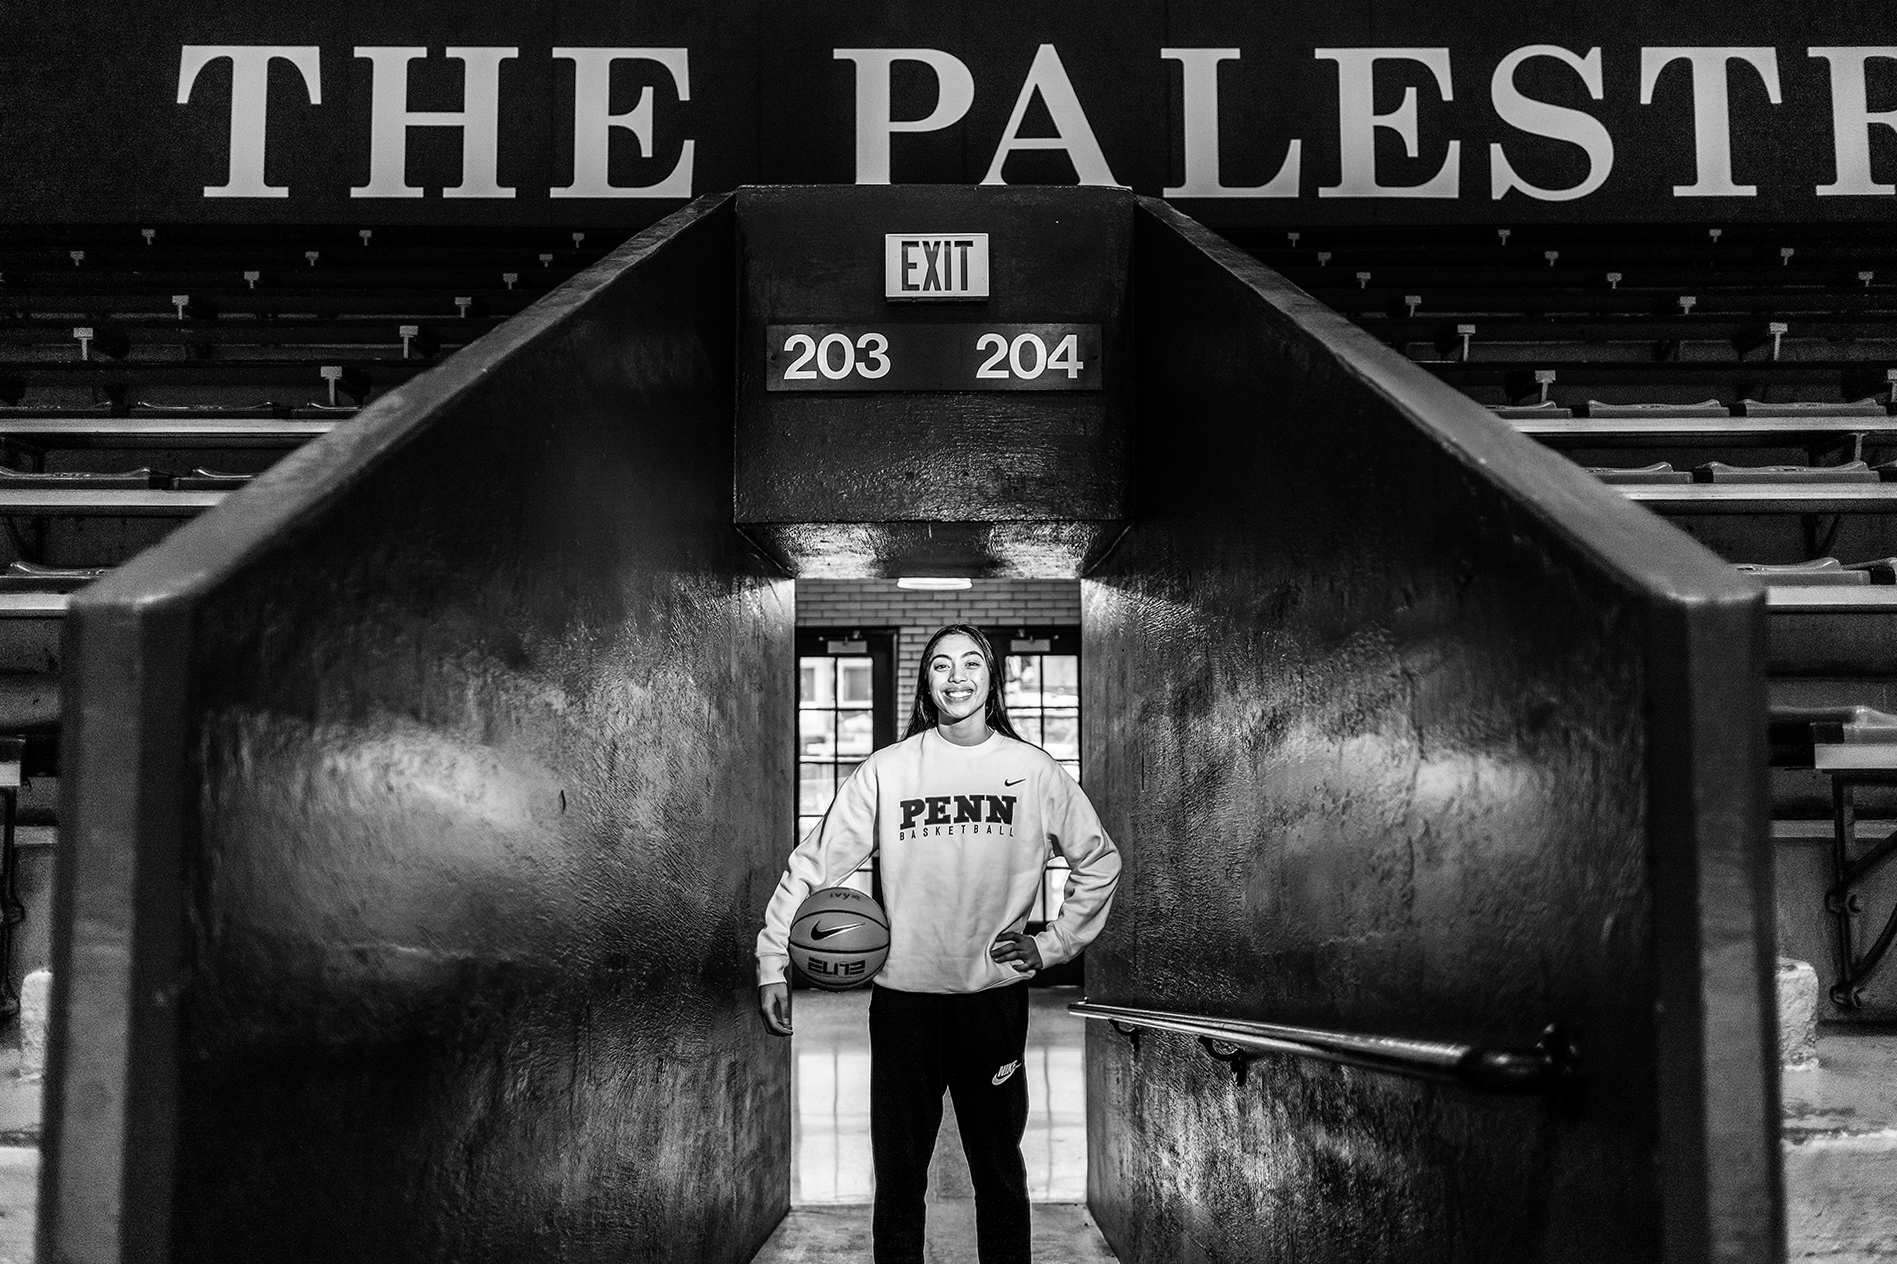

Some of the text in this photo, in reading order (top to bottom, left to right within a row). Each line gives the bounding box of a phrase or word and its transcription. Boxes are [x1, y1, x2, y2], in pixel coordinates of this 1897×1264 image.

[176, 44, 695, 199] THE
[901, 240, 974, 292] EXIT
[783, 332, 1084, 380] 203 204
[899, 794, 1017, 830] PENN
[899, 824, 1014, 841] BASKETBALL
[807, 956, 866, 976] ELITE
[996, 1059, 1018, 1078] NIKE
